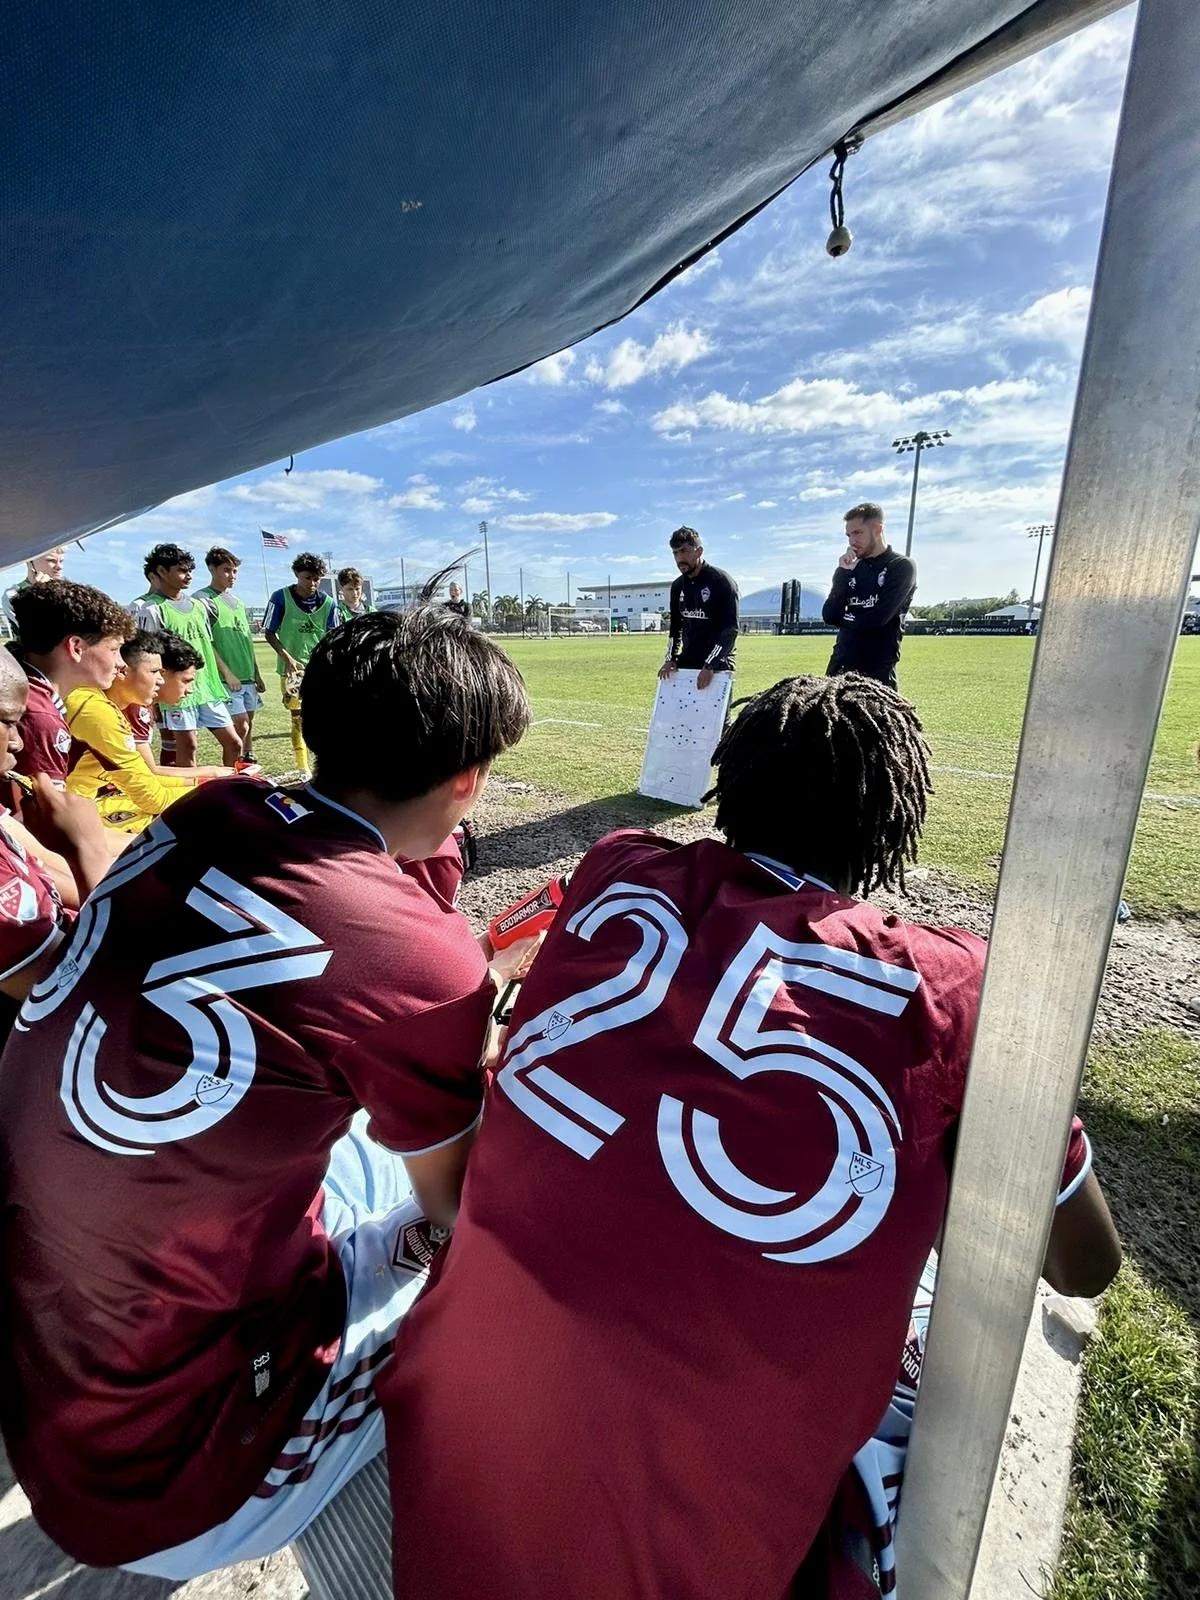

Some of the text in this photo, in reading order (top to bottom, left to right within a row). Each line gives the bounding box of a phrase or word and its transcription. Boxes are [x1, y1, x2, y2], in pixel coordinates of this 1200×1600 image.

[499, 900, 540, 932] BODYARMOR
[204, 1075, 221, 1086] MLS
[497, 881, 922, 1265] 25
[854, 1155, 872, 1170] MLS
